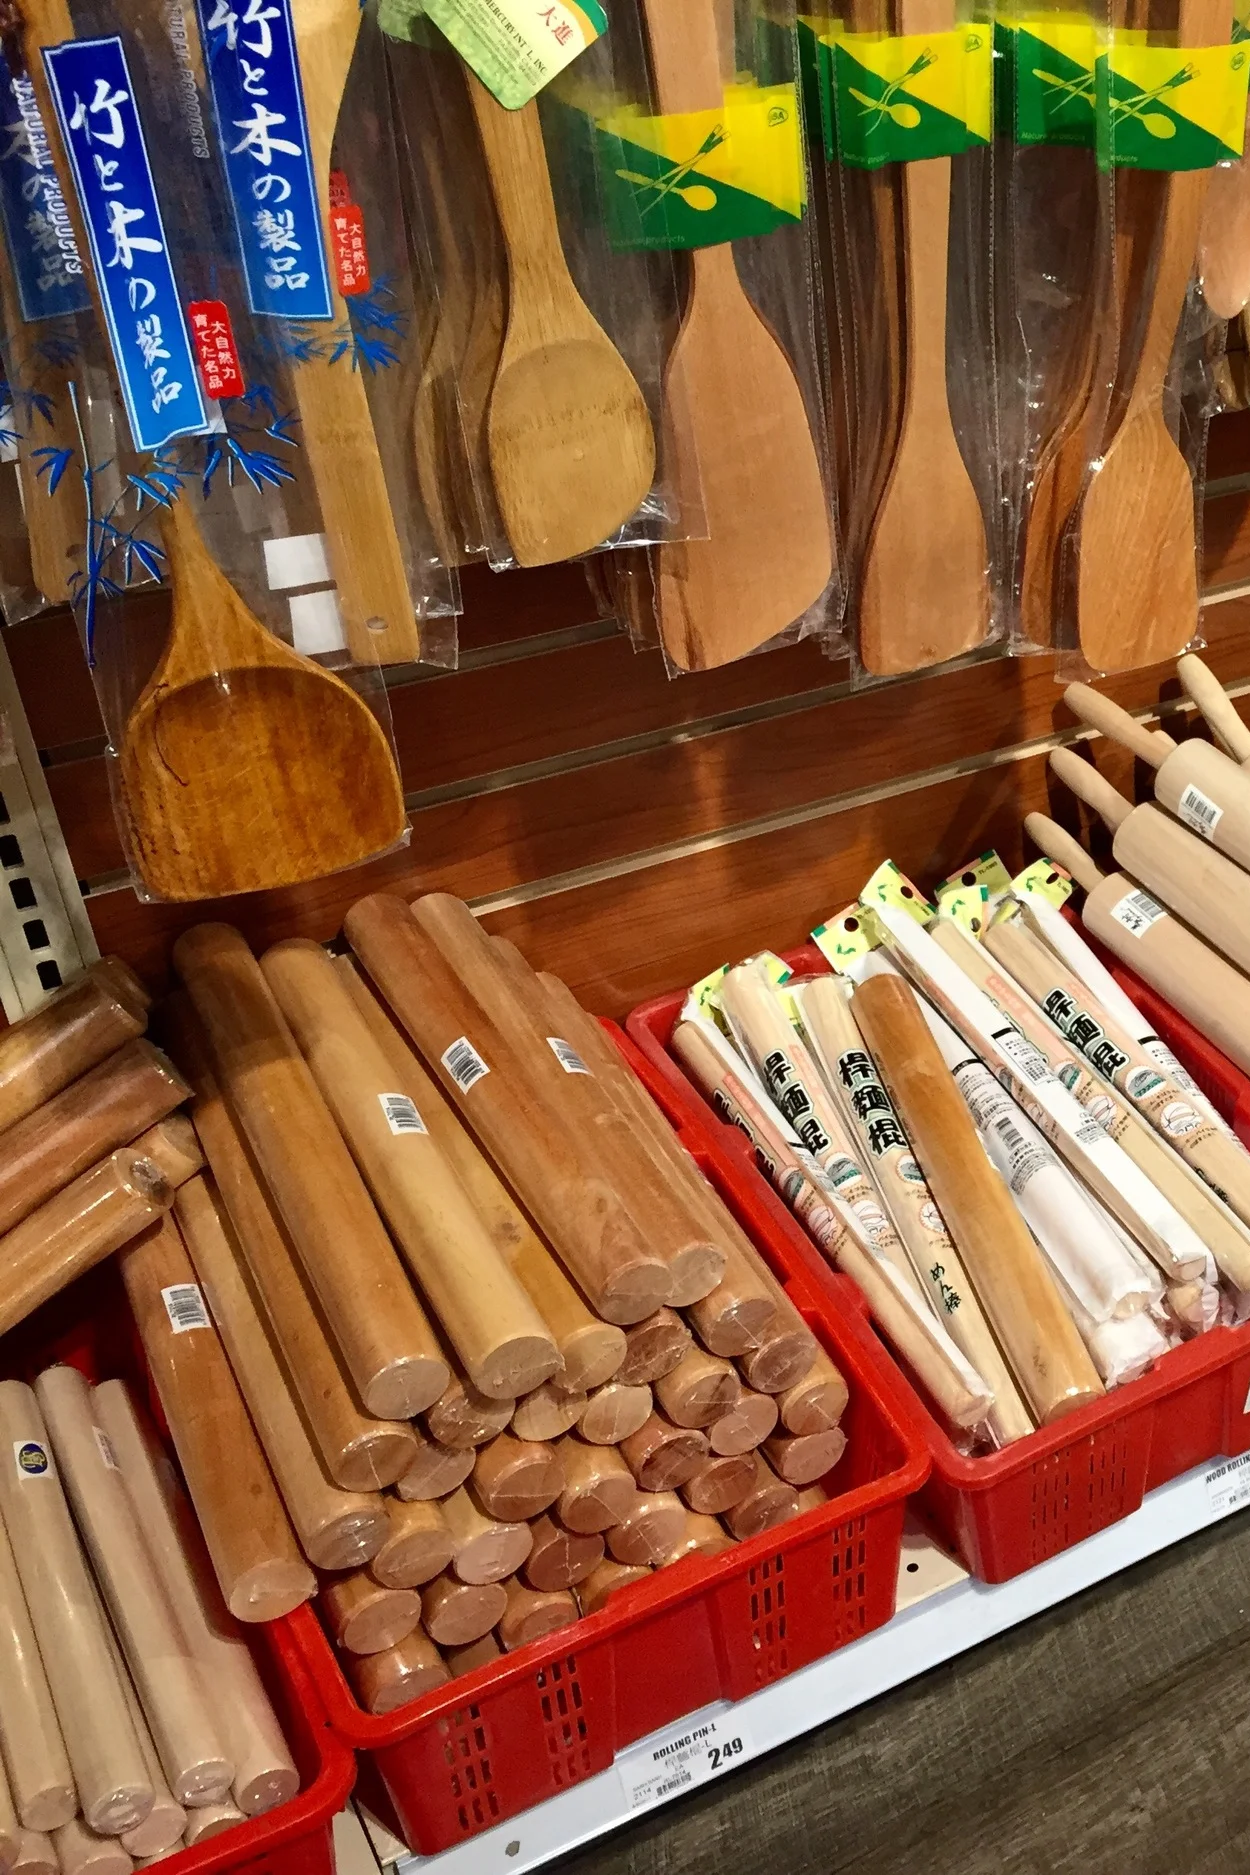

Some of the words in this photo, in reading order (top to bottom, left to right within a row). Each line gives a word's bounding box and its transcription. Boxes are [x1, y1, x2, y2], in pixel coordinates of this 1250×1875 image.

[207, 0, 311, 291] 竹と木の製品
[70, 79, 183, 414] 竹と木の製品
[1206, 1464, 1227, 1484] WOOD
[653, 1734, 692, 1762] ROLLING
[707, 1737, 744, 1771] 249
